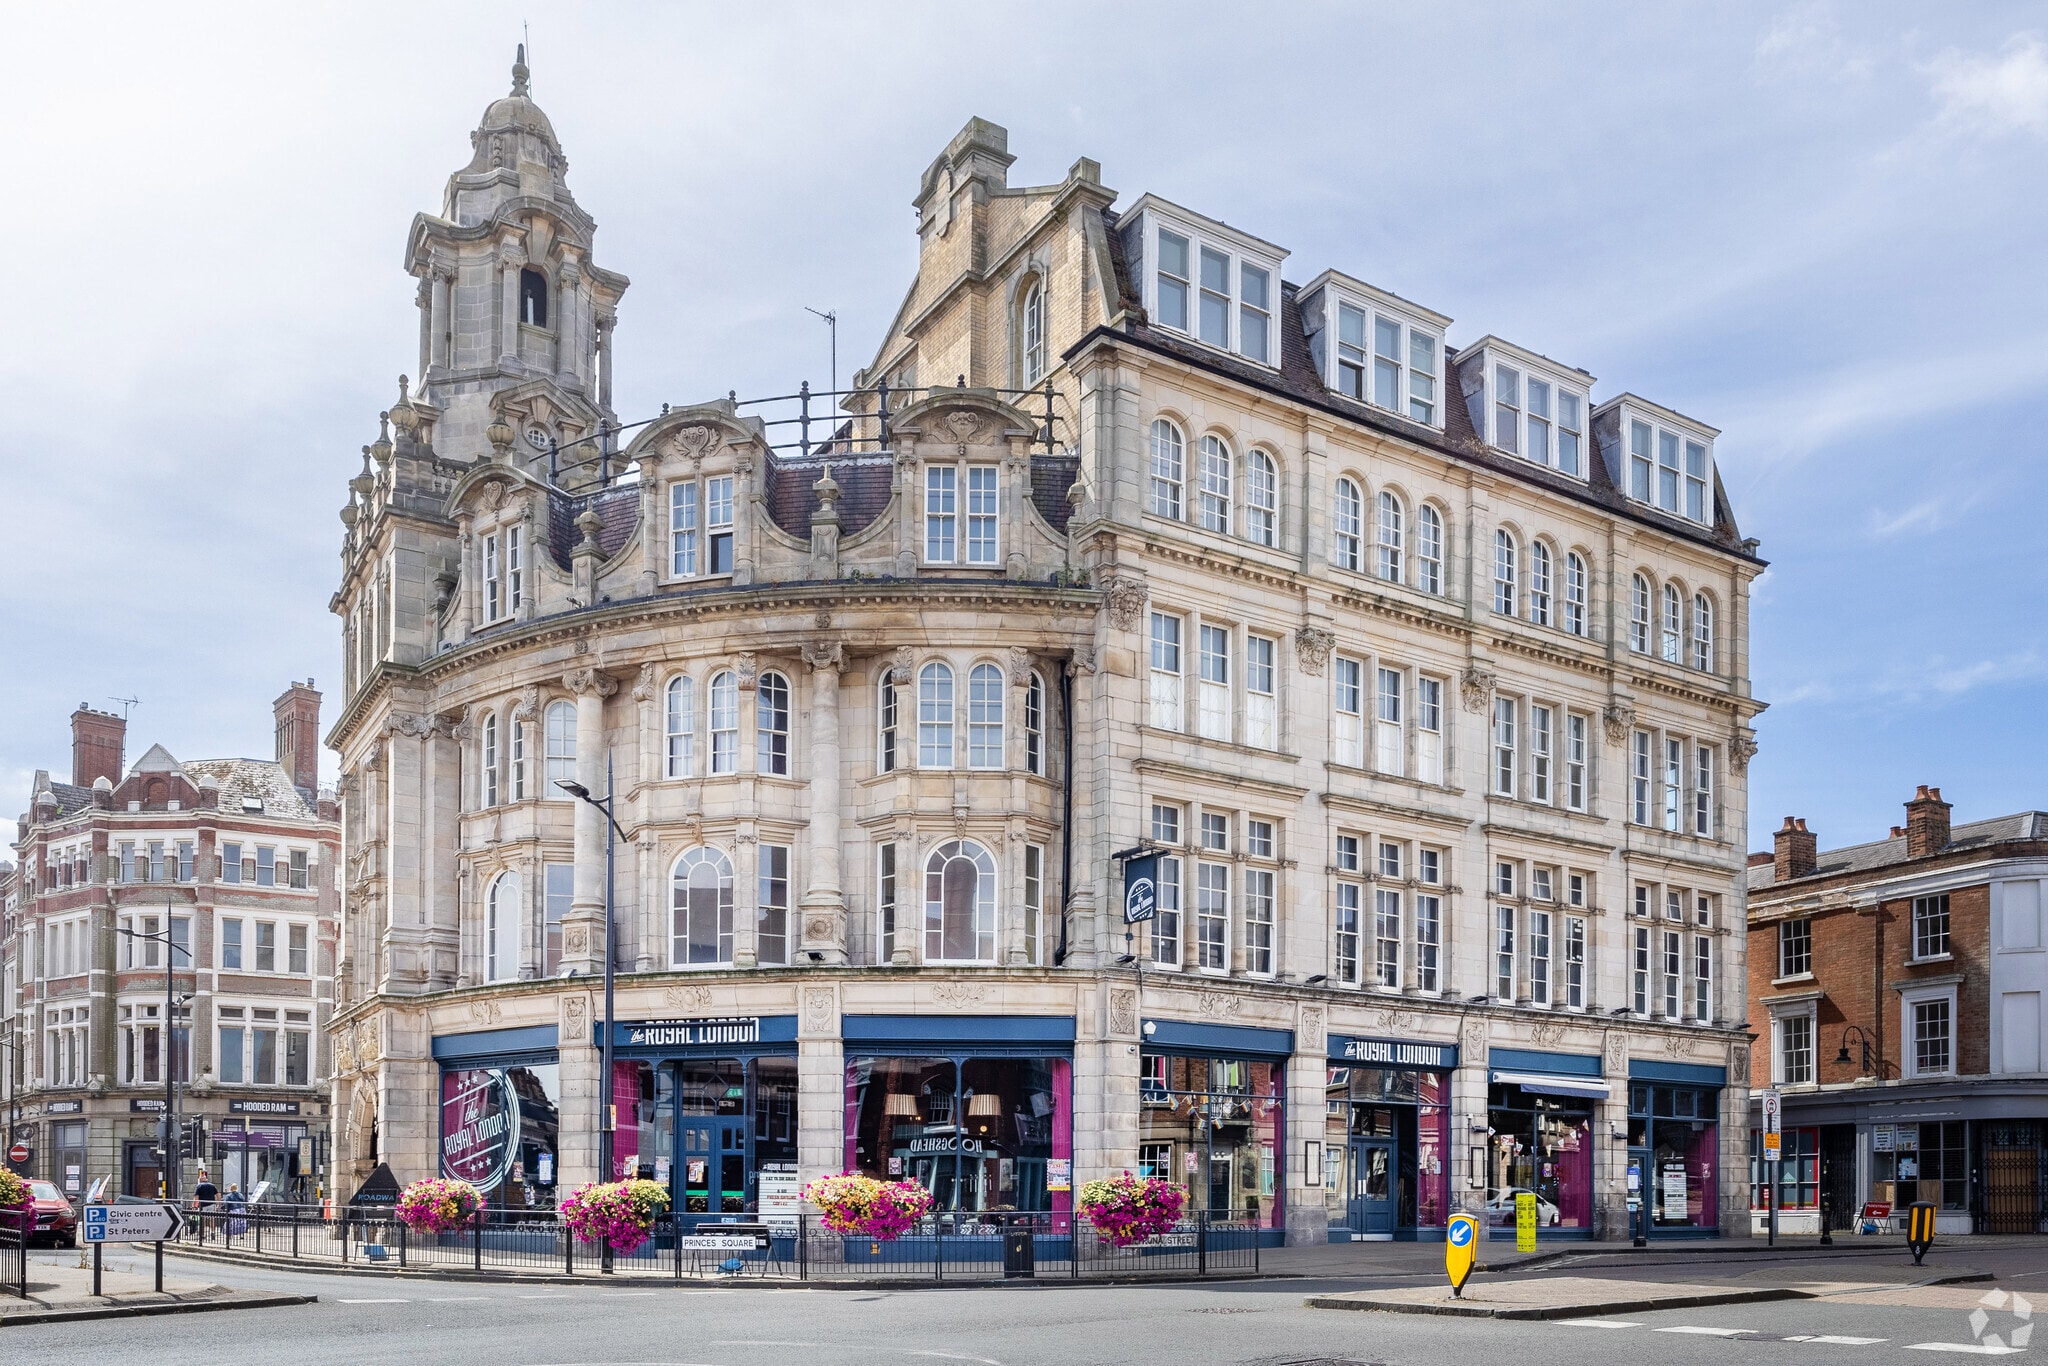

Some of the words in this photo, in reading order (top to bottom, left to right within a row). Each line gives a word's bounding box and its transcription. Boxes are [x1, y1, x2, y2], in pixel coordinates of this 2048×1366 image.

[630, 1028, 645, 1042] the
[645, 1020, 694, 1045] ROYAL
[699, 1017, 760, 1043] LONDON
[1356, 1041, 1394, 1062] ROYAL
[1397, 1044, 1441, 1066] LONDON
[243, 1102, 271, 1112] HOODED
[271, 1103, 287, 1113] RAM
[443, 1127, 474, 1157] ROYAL
[109, 1210, 132, 1218] Civic
[122, 1227, 150, 1235] Peters
[684, 1239, 717, 1247] PRINCES
[722, 1239, 754, 1247] SQUARE
[1167, 1235, 1195, 1245] STREET
